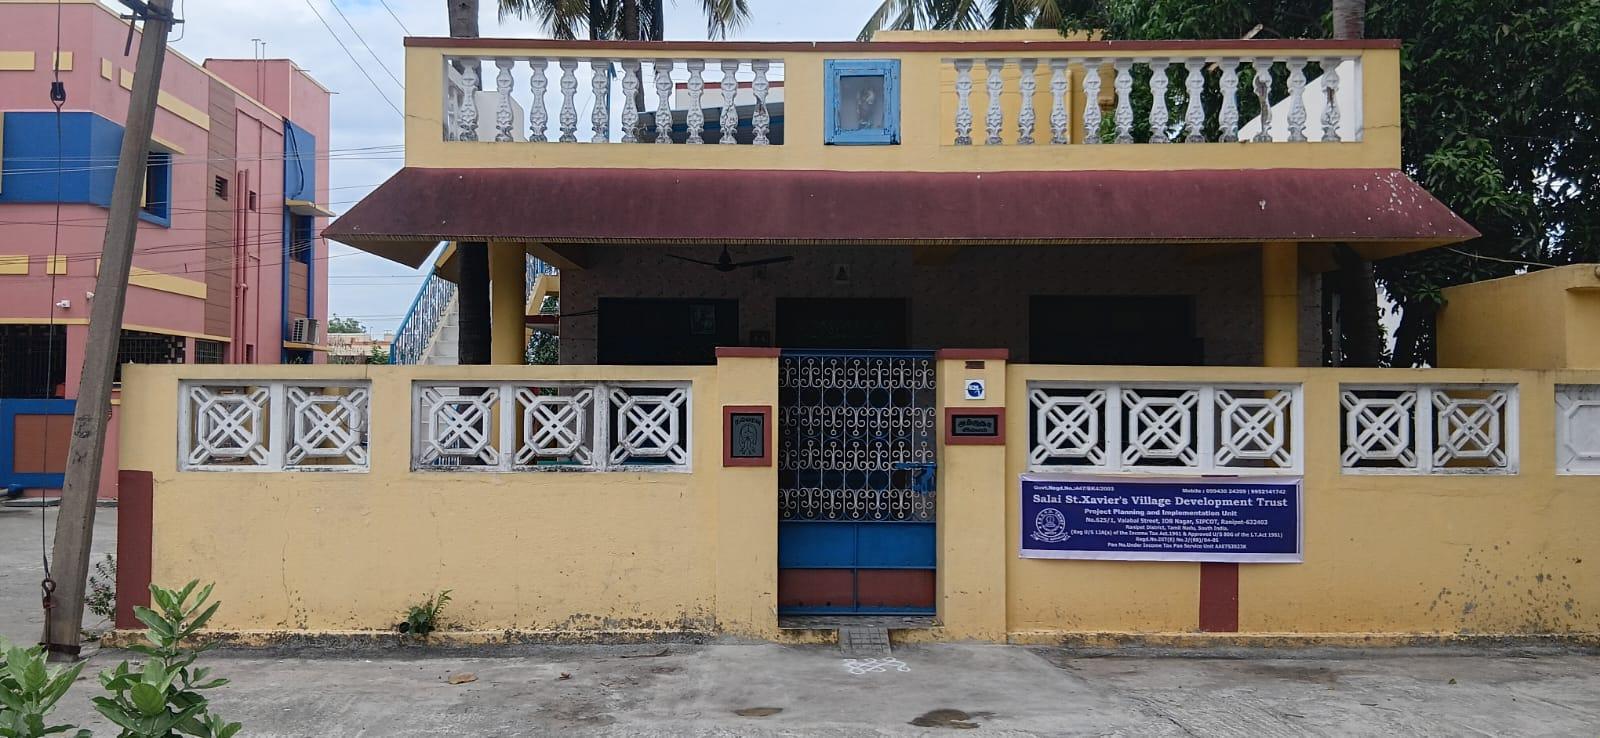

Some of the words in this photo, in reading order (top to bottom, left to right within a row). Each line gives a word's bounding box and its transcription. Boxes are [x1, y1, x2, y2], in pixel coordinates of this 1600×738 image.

[1033, 494, 1062, 504] Salai
[1065, 495, 1128, 505] St.Xavier's
[1131, 496, 1171, 507] Village
[1175, 497, 1253, 508] Development
[1256, 497, 1288, 507] Trust
[1084, 508, 1111, 516] Project
[1113, 509, 1144, 517] Planning
